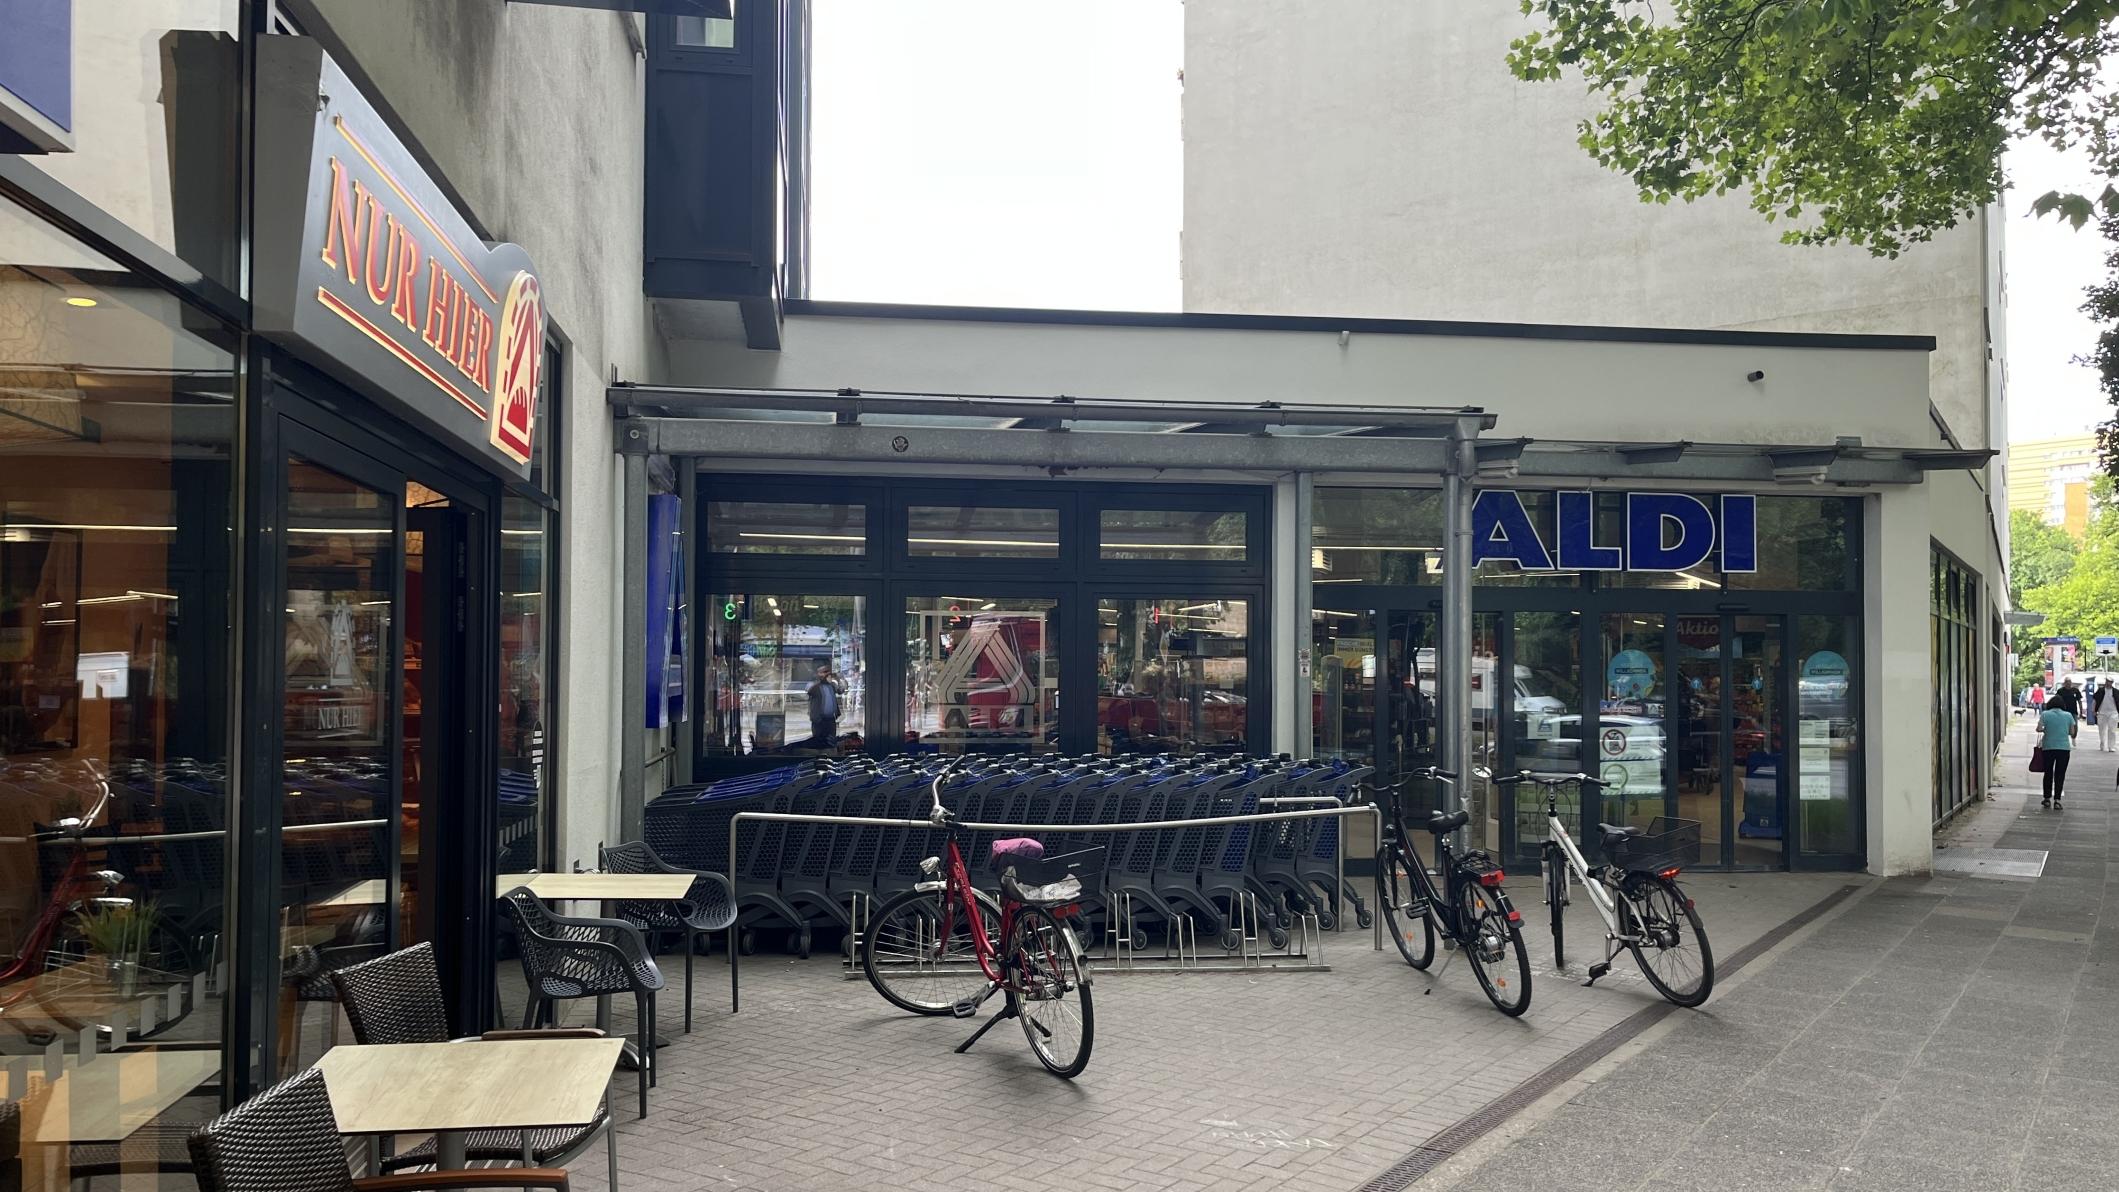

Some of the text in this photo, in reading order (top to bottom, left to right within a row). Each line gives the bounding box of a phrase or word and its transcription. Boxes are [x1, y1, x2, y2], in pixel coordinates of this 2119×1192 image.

[321, 155, 496, 394] NUR HIER
[1471, 489, 1758, 573] ALDI
[318, 706, 340, 729] NUR
